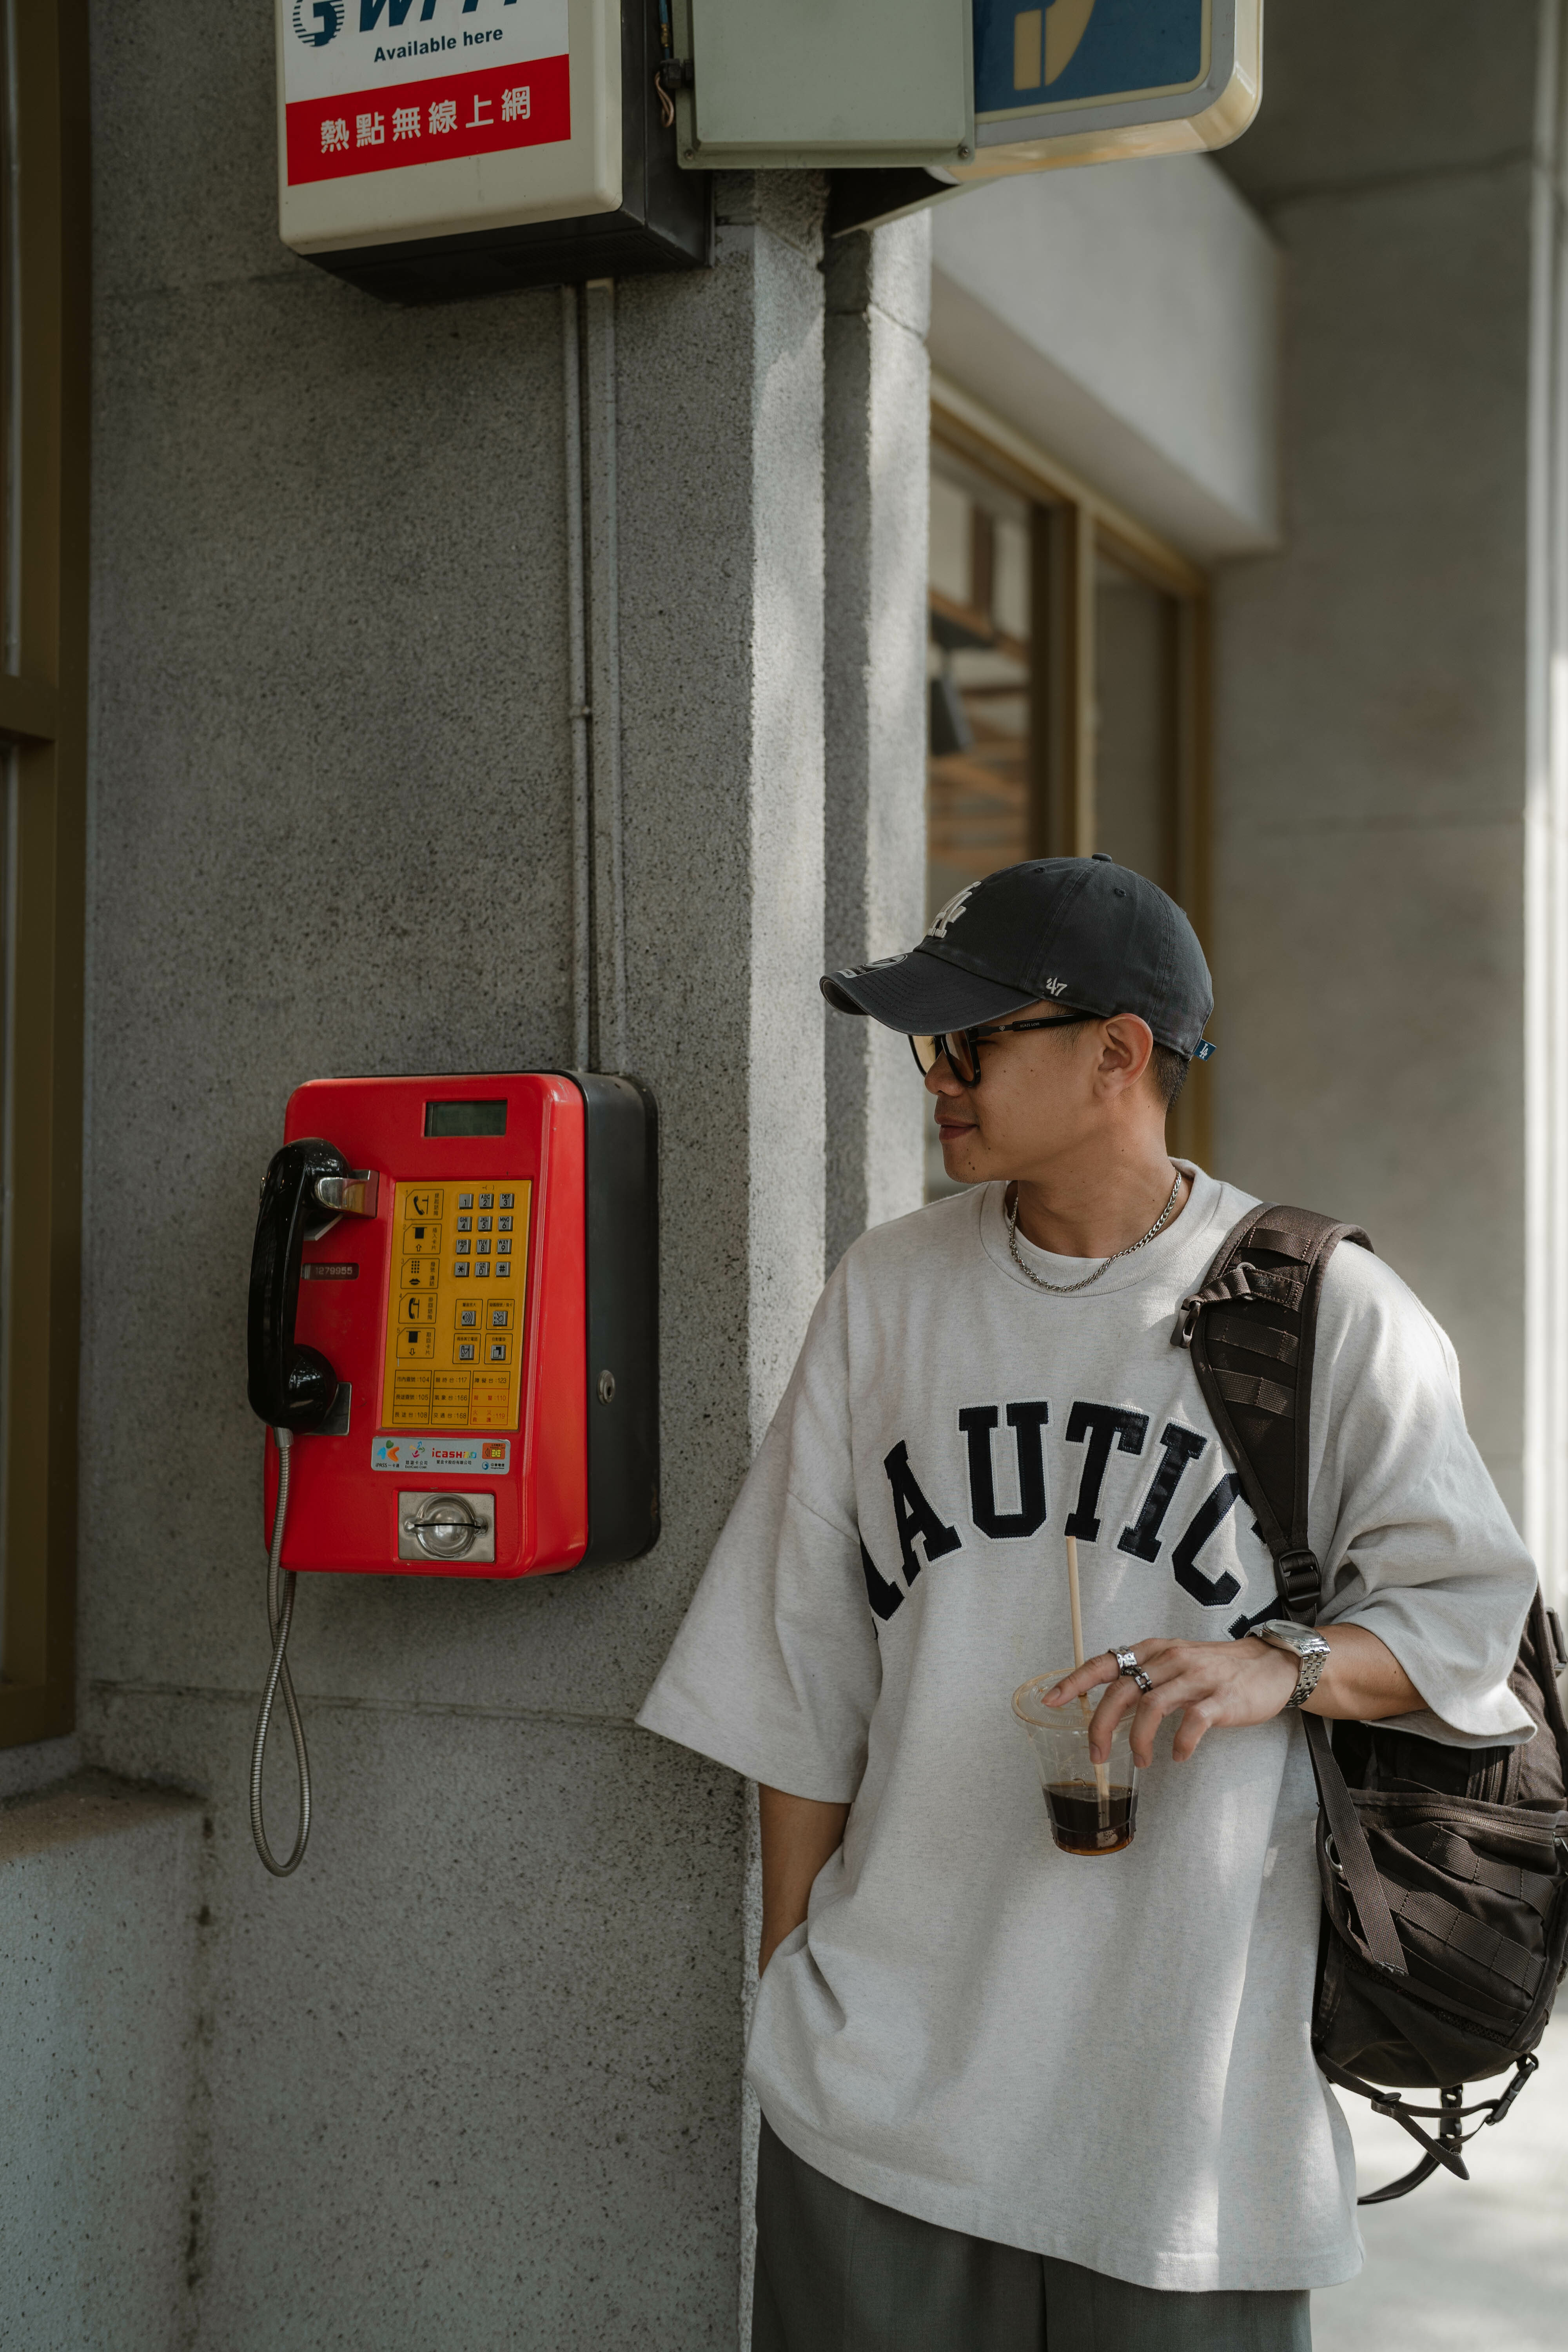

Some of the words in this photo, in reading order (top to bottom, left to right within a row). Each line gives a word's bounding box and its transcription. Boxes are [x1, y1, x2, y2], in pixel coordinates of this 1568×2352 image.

[374, 36, 456, 63] Available
[463, 29, 503, 46] here
[320, 86, 530, 153] 熱點無線上網
[316, 1267, 353, 1275] 1279955
